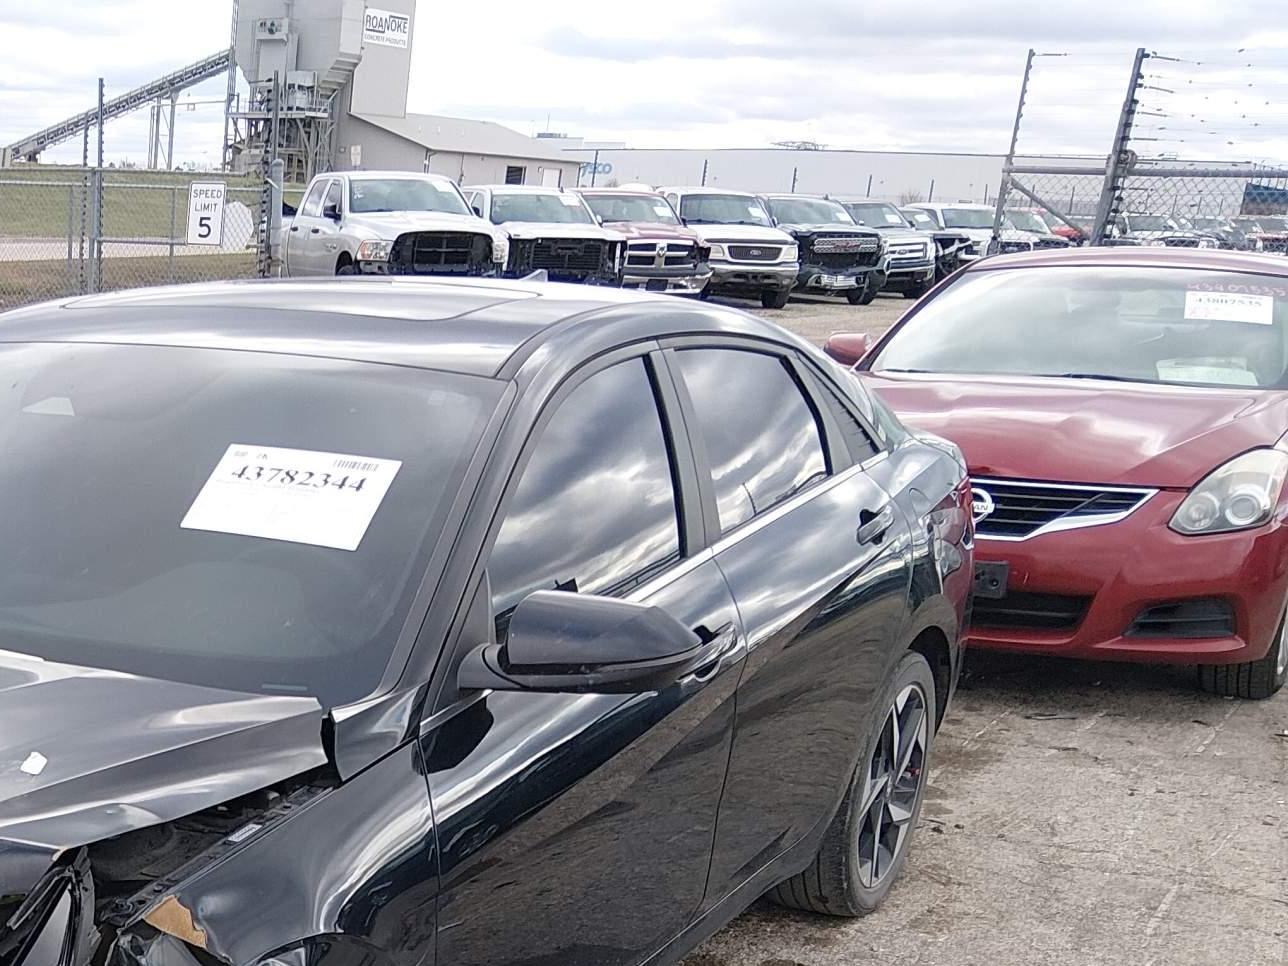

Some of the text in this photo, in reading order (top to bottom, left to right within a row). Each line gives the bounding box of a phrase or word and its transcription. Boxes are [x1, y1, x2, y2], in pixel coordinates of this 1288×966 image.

[365, 14, 408, 34] ROANOKE
[192, 189, 223, 199] SPEED
[194, 202, 218, 213] LIMIT
[198, 216, 212, 239] 5
[231, 465, 368, 492] 43782344
